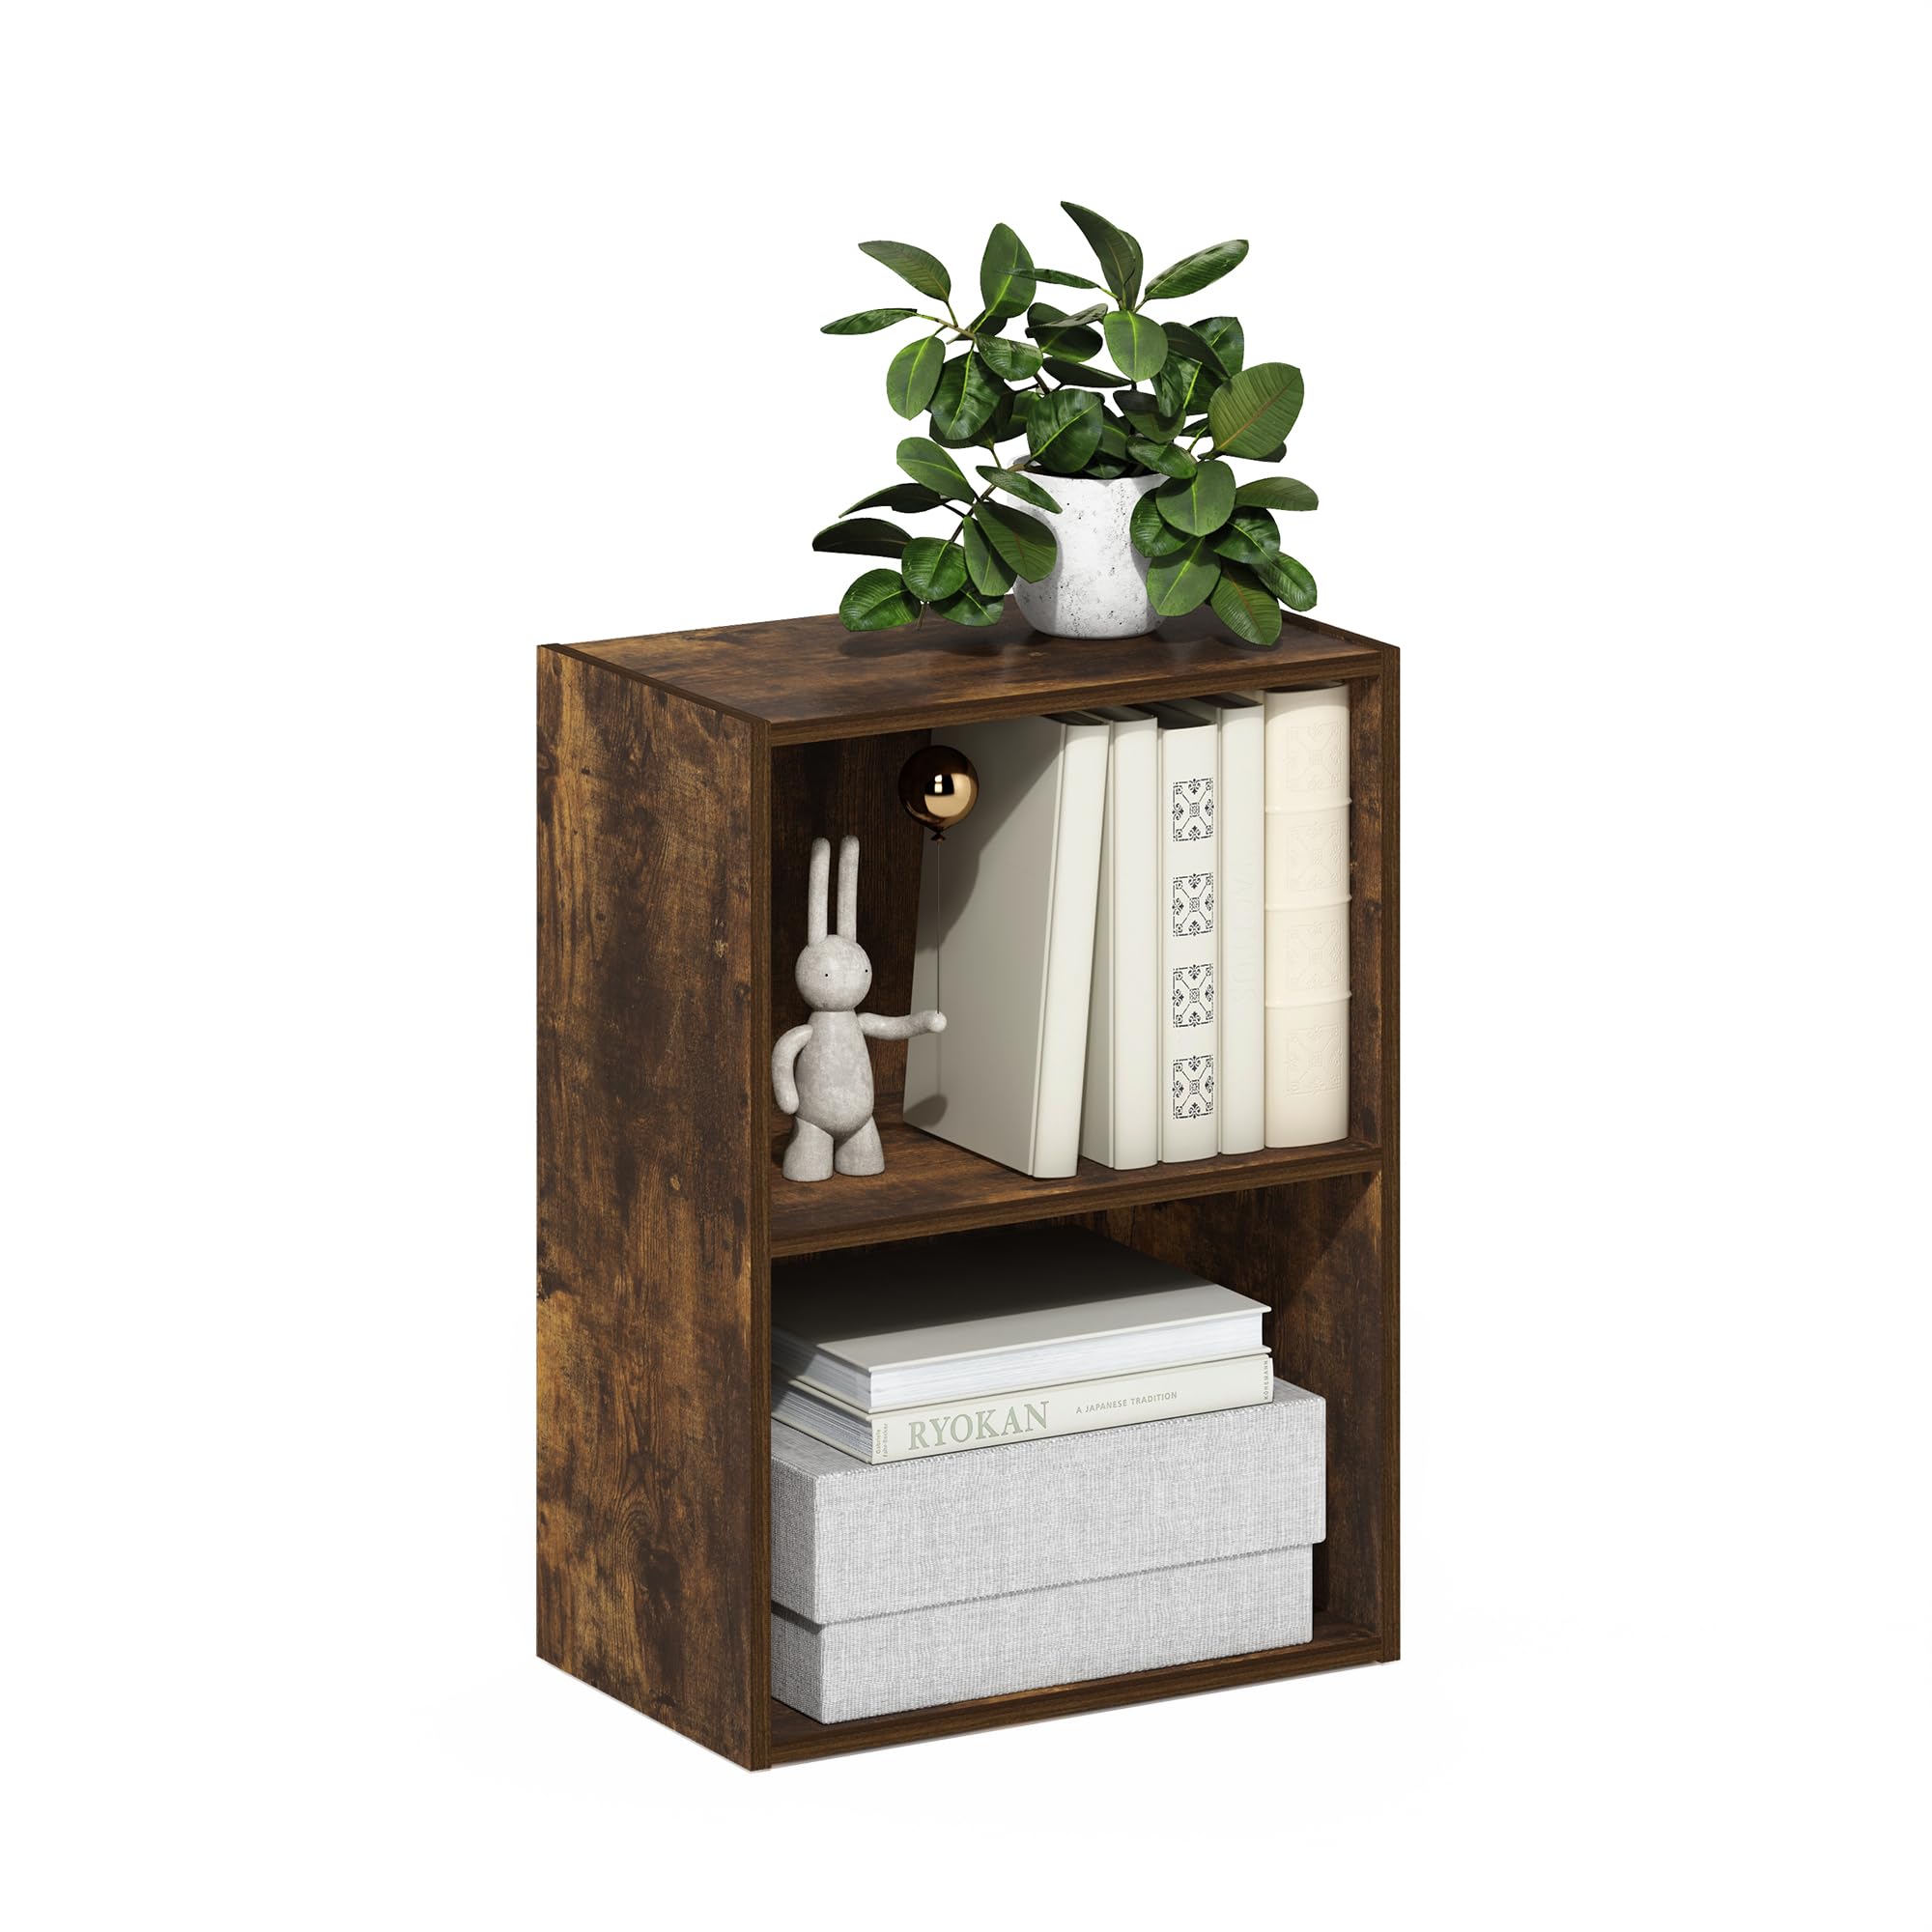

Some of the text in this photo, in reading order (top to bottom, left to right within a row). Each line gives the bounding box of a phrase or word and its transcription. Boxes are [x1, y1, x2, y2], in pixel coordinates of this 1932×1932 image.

[908, 1401, 1050, 1451] RYOKAN
[1085, 1399, 1127, 1413] JAPANESE
[1130, 1391, 1178, 1406] TRADITION
